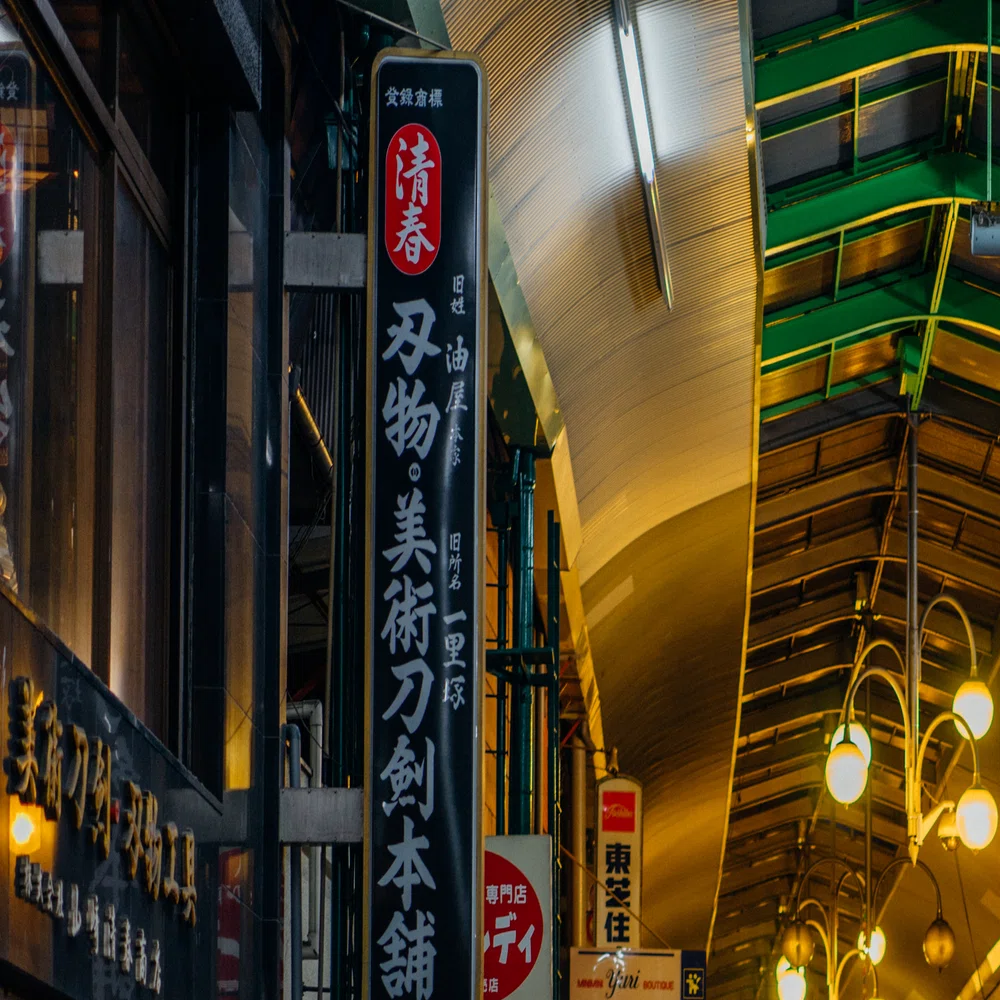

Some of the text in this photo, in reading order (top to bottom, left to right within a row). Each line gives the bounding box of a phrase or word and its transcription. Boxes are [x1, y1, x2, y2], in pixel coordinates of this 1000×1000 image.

[384, 86, 444, 108] 登録商標
[394, 131, 436, 265] 清春
[450, 274, 466, 315] 旧姓
[382, 297, 443, 462] 刃物
[446, 334, 469, 412] 油屋
[442, 531, 467, 712] 旧所名 一里塚
[485, 884, 527, 905] 専門店
[605, 968, 640, 999] Yuri
[642, 980, 675, 992] BOUTIQUE
